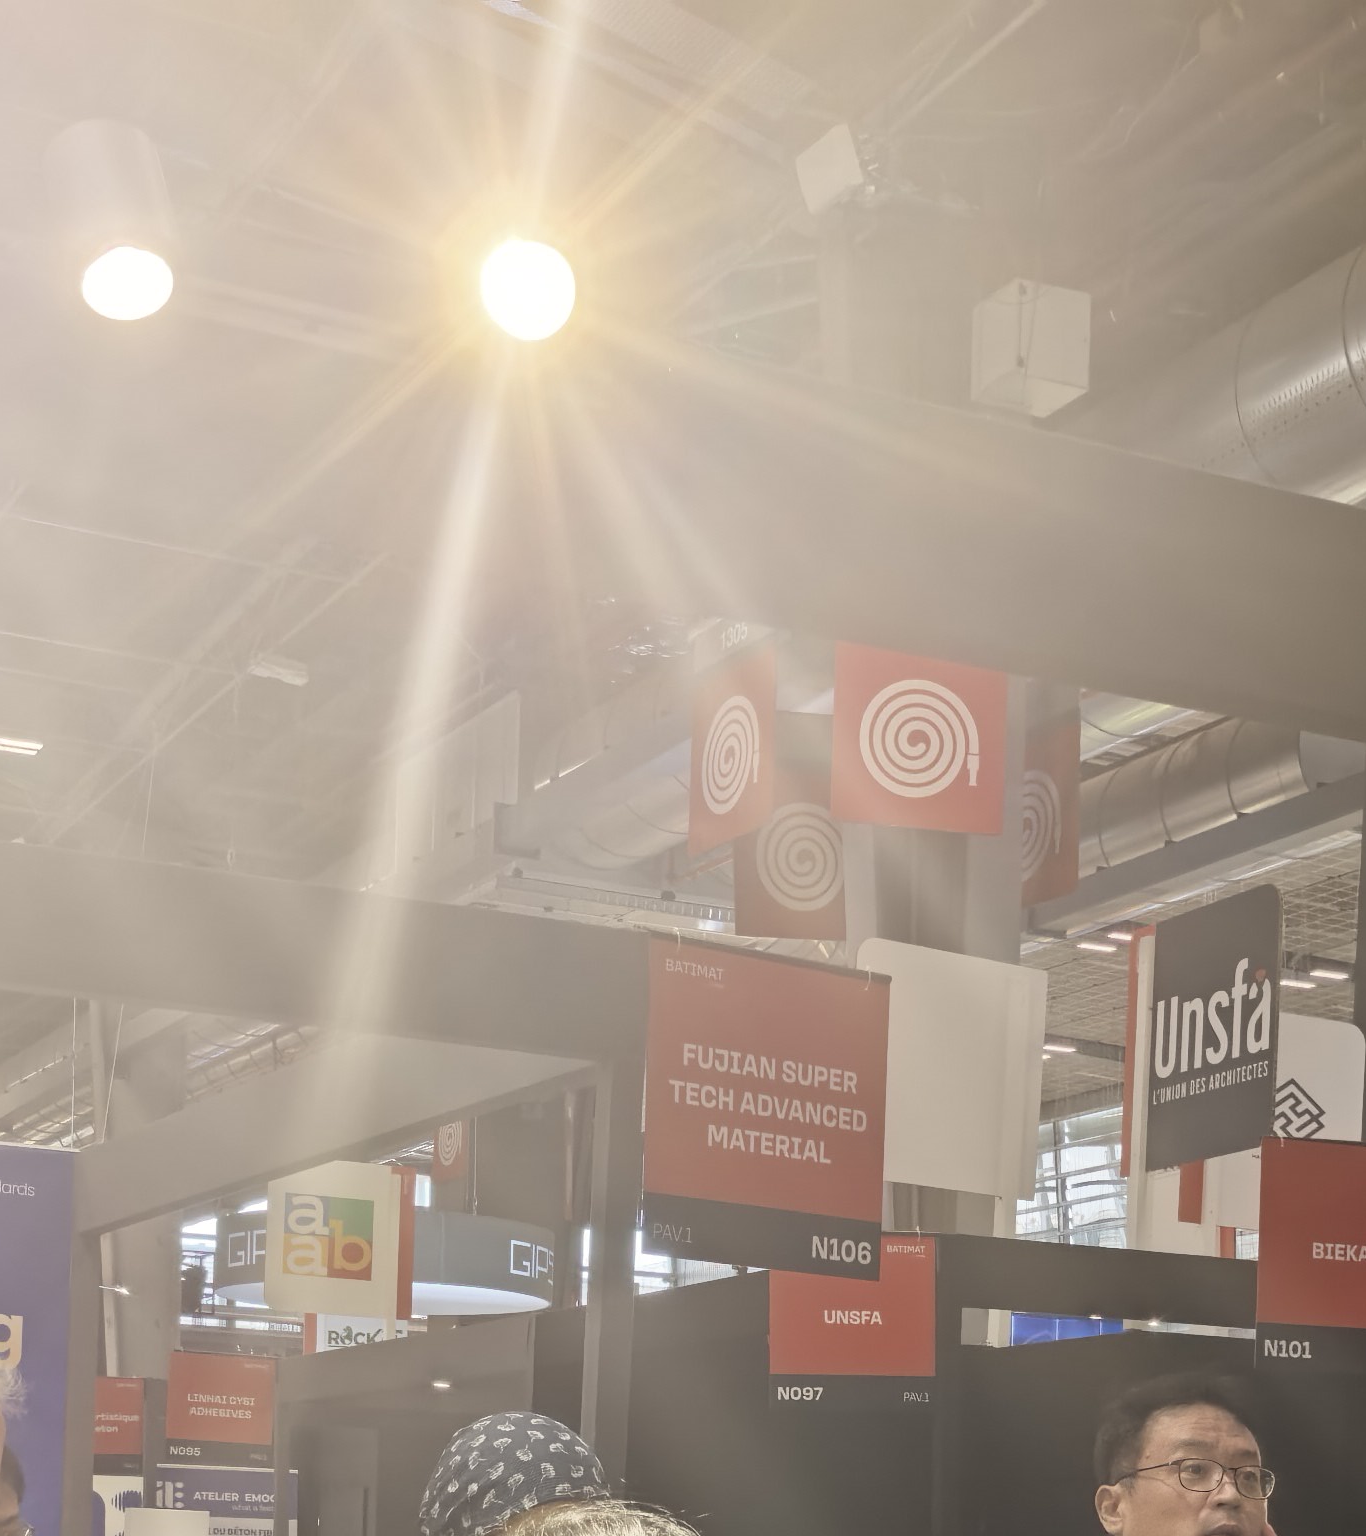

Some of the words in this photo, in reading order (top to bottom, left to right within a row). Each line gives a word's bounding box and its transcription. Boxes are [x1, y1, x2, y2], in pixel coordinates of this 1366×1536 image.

[665, 958, 724, 981] BATIMAT
[682, 1043, 776, 1081] FUJIAN
[781, 1060, 858, 1094] SUPER
[1153, 1083, 1187, 1105] L'UNION
[1189, 1077, 1206, 1096] DES
[1208, 1060, 1269, 1091] ARCHITECTES
[668, 1080, 734, 1111] TECH
[740, 1091, 867, 1132] ADVANCED
[707, 1125, 831, 1164] MATERIAL
[653, 1223, 693, 1244] PAV.1
[811, 1235, 872, 1265] N106
[886, 1245, 925, 1255] BATIMAT
[823, 1310, 883, 1326] UNSFA
[1264, 1339, 1312, 1360] N101
[777, 1387, 823, 1401] N097
[189, 1406, 252, 1419] ADHESIVES
[194, 1491, 240, 1502] ATELIER
